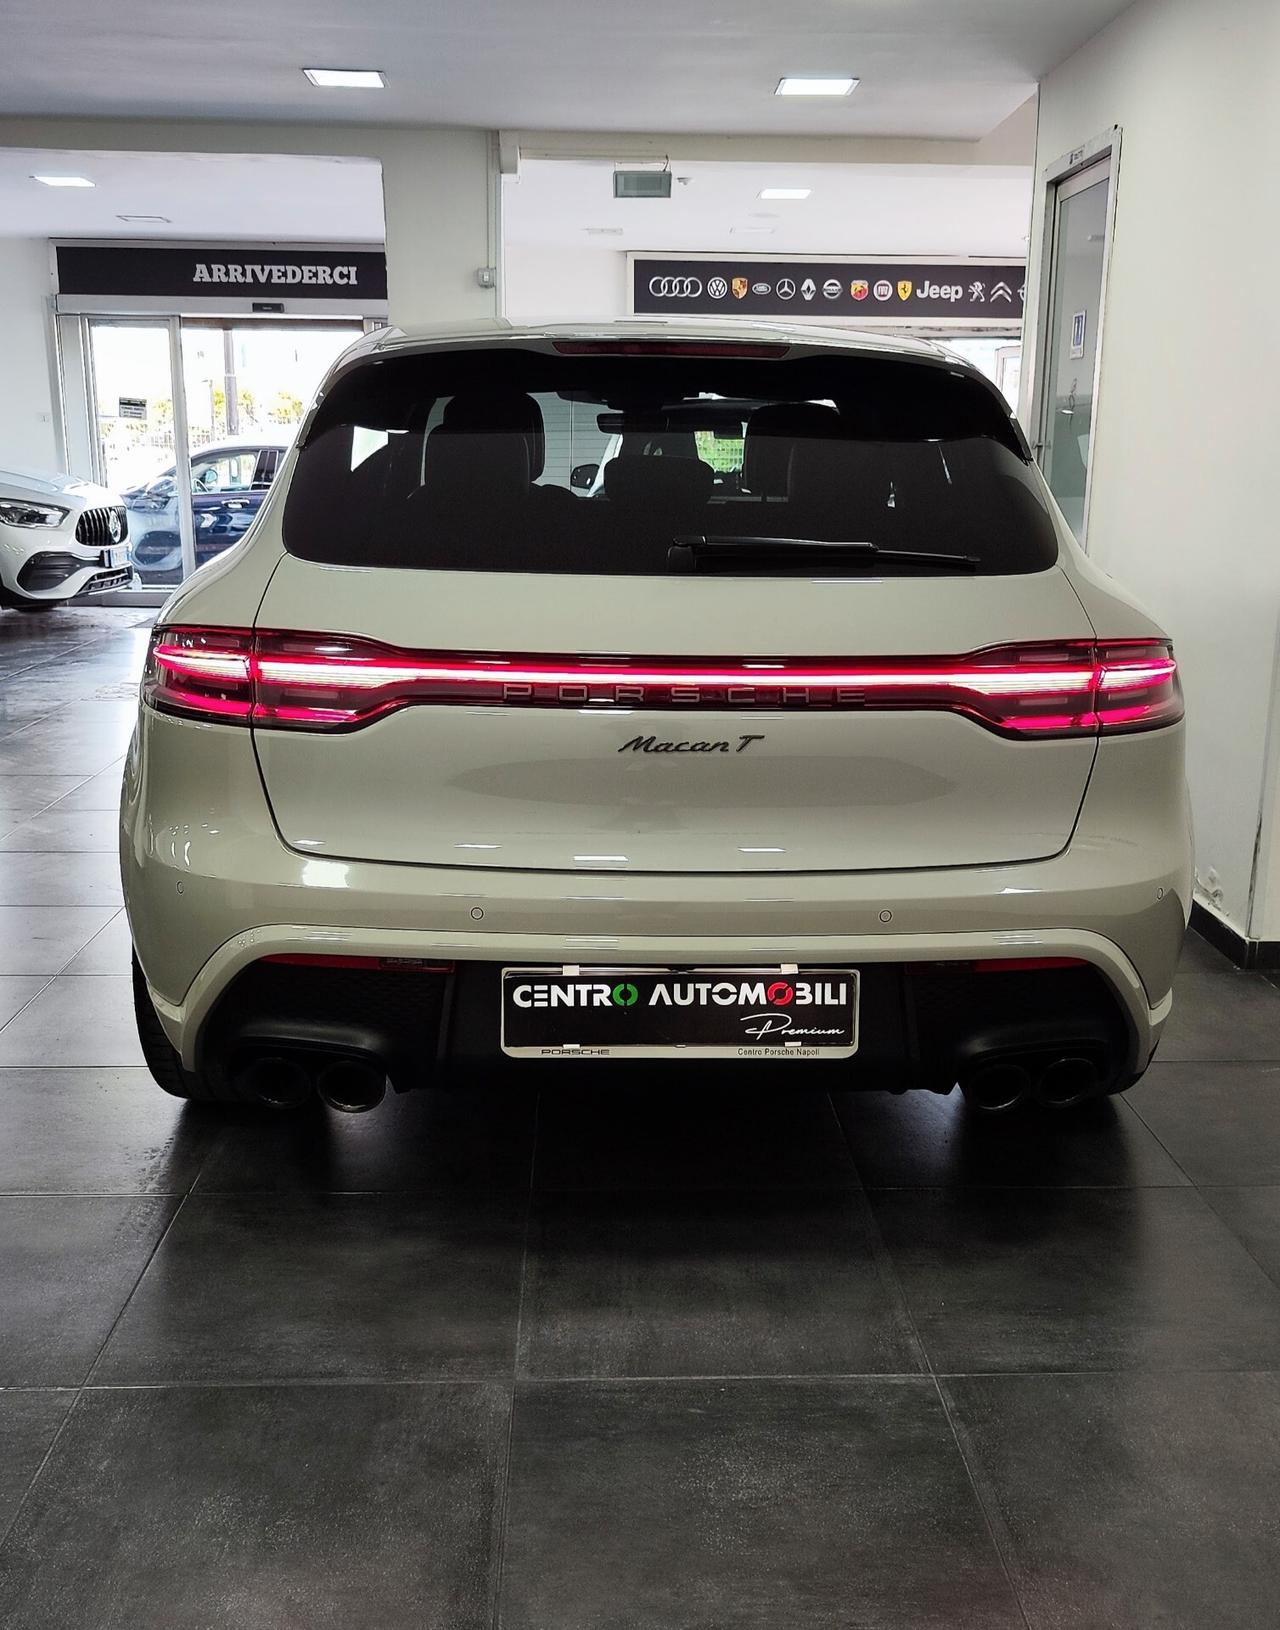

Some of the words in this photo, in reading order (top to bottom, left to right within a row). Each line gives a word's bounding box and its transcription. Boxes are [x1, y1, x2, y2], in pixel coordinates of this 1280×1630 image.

[193, 264, 358, 285] ARRIVEDERCI
[916, 280, 963, 302] Jeep
[503, 683, 866, 703] PORSCHE
[618, 736, 730, 753] Macan
[736, 735, 765, 752] T
[513, 983, 639, 1008] CENTRO
[648, 981, 847, 1006] AUTOMOBILI
[740, 1013, 845, 1040] Premium
[737, 1047, 762, 1056] Centro
[765, 1047, 795, 1056] Porsche
[797, 1047, 820, 1057] Napoli
